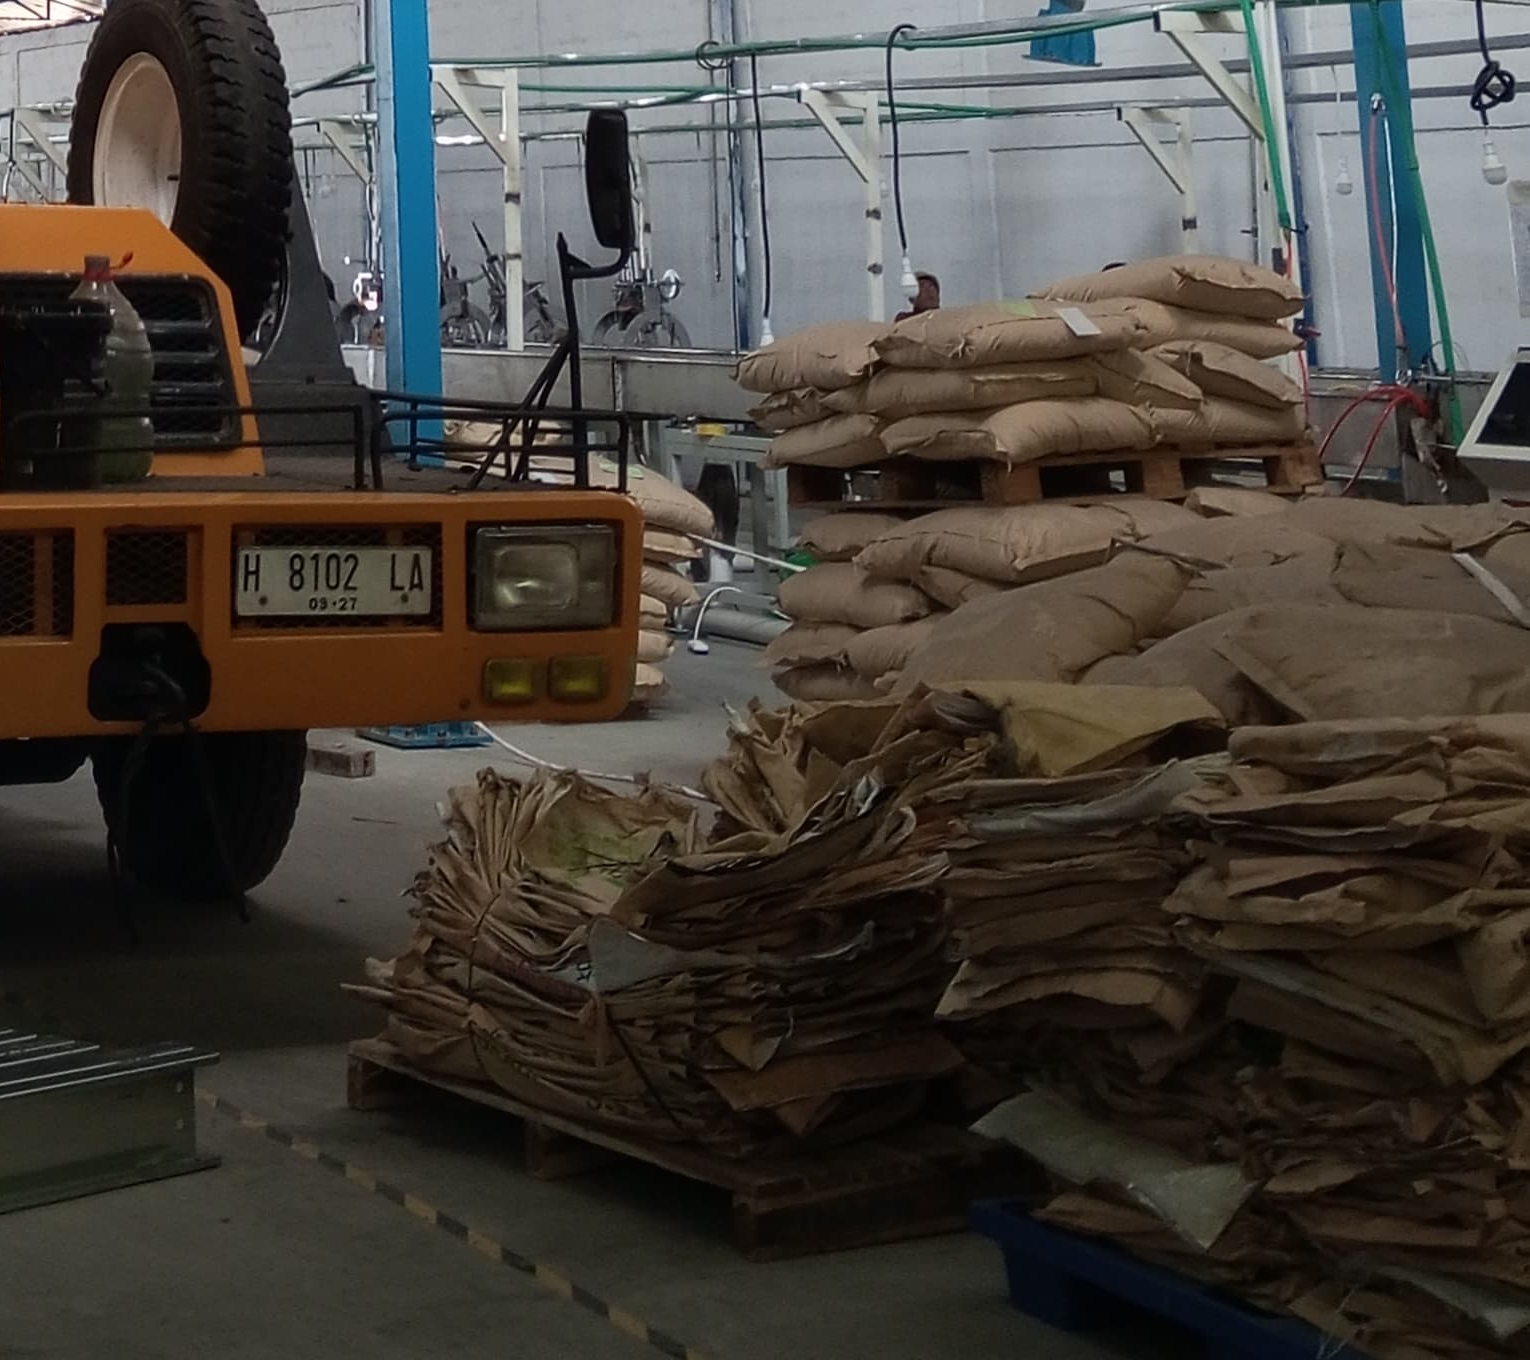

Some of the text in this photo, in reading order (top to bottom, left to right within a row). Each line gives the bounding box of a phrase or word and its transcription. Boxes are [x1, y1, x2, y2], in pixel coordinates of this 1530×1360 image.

[243, 553, 424, 592] H 8102 LA
